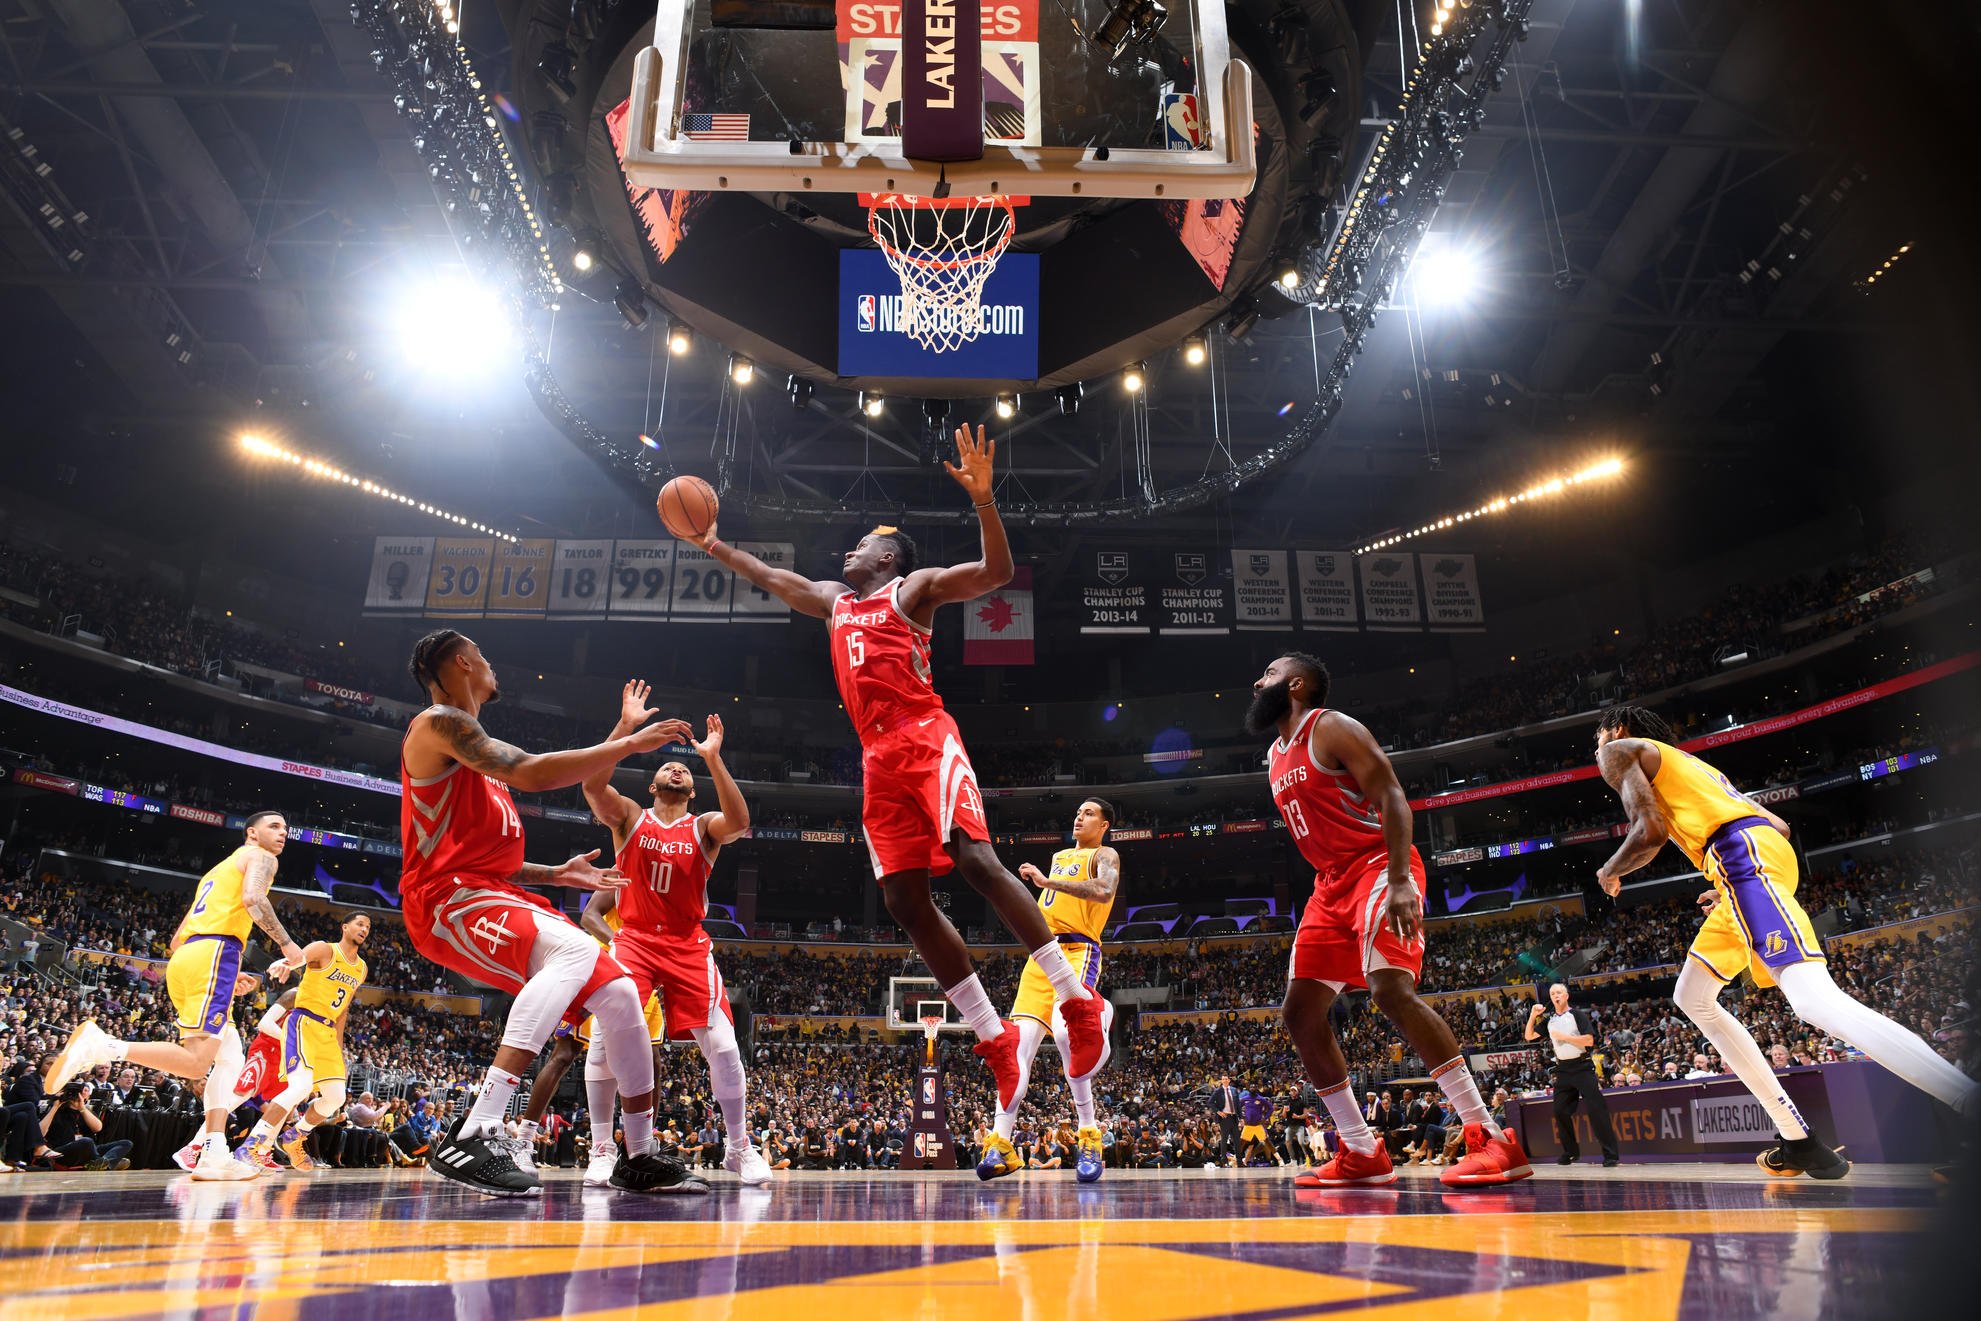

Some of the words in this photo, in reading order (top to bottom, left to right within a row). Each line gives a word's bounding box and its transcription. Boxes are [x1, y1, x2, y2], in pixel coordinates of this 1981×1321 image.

[850, 4, 1022, 35] STES
[1171, 141, 1188, 151] NBA
[383, 545, 423, 556] MILLER
[443, 547, 486, 557] VACHON
[564, 548, 603, 559] TAYLOR
[620, 548, 669, 560] GRETZKY
[435, 565, 481, 598] 30
[501, 565, 536, 598] 16
[561, 567, 597, 599] 18
[618, 567, 664, 600] 99
[679, 568, 725, 601] 20
[1084, 587, 1122, 597] STANLEY
[1125, 586, 1145, 596] CUP
[1162, 588, 1201, 598] STANLEY
[1203, 588, 1223, 598] CUP
[1238, 588, 1287, 596] CONFERENCE
[1084, 596, 1146, 607] CHAMPIONS
[1162, 598, 1224, 609] CHAMPIONS
[1241, 596, 1285, 605] CHAMPIONS
[1093, 610, 1138, 622] 2013-14
[1247, 607, 1280, 616] 2013-14
[835, 610, 887, 630] ROCKETS
[1172, 612, 1216, 624] 2011-12
[846, 631, 865, 669] 15
[317, 681, 363, 702] TOYOTA
[41, 700, 103, 724] Advantage
[1706, 735, 1729, 746] Give
[1731, 729, 1751, 742] your
[1754, 716, 1797, 734] business
[1797, 709, 1823, 721] every
[1885, 756, 1898, 766] 103
[1919, 753, 1938, 765] NBA
[281, 761, 322, 778] STAPLES
[324, 770, 364, 786] Business
[1859, 763, 1876, 774] BOS
[1887, 765, 1900, 774] 101
[1861, 771, 1874, 781] NY
[87, 784, 104, 795] TOR
[113, 790, 126, 799] 117
[1425, 798, 1445, 807] Give
[1446, 794, 1465, 804] your
[1465, 787, 1501, 800] business
[1502, 782, 1525, 794] every
[85, 791, 104, 802] WAS
[1749, 787, 1799, 804] OYOTA
[111, 797, 125, 806] 113
[143, 803, 161, 813] NBA
[172, 805, 223, 825] TOSHIBA
[493, 794, 521, 838] 14
[1283, 798, 1309, 840] 13
[1190, 824, 1200, 832] LAL
[1273, 818, 1288, 828] Stu
[287, 833, 301, 841] IND
[766, 831, 798, 839] DELTA
[802, 831, 843, 842] STAPLES
[1111, 830, 1152, 840] TOSHIBA
[343, 841, 358, 850] NBA
[377, 844, 403, 855] DELT
[639, 833, 693, 855] ROCKETS
[1539, 842, 1554, 851] NBA
[1438, 850, 1482, 866] STAPLES
[1489, 851, 1501, 859] IND
[650, 861, 673, 894] 10
[193, 880, 214, 914] 2
[331, 987, 346, 1009] 3
[1582, 1109, 1656, 1143] TKETS
[1661, 1107, 1682, 1139] AT
[1697, 1104, 1774, 1134] LAKERS.COM
[926, 1133, 936, 1141] NBA
[926, 1141, 943, 1151] League
